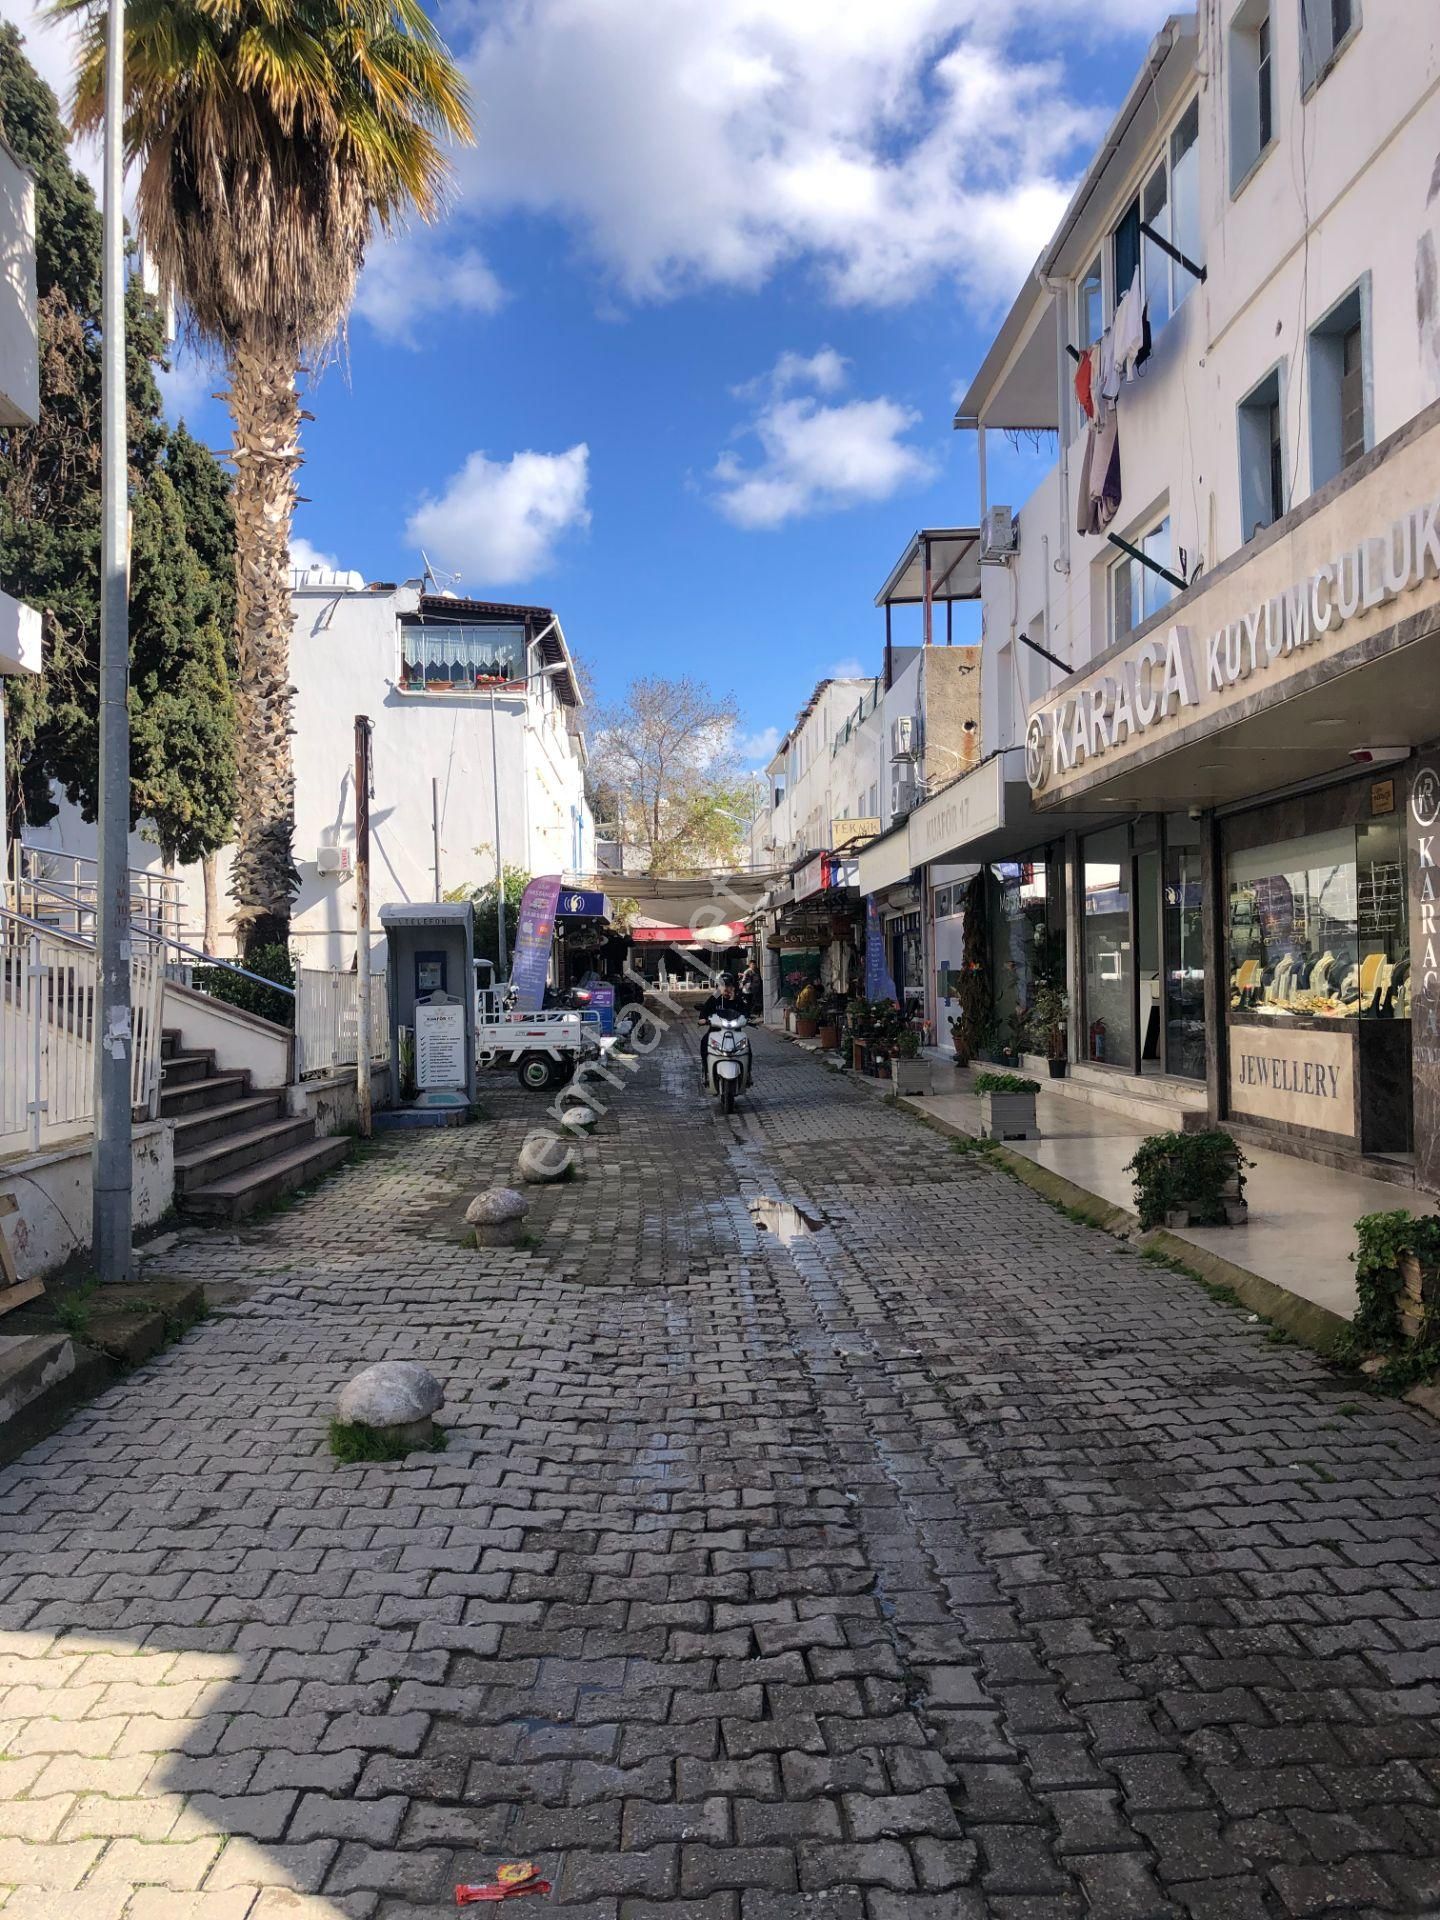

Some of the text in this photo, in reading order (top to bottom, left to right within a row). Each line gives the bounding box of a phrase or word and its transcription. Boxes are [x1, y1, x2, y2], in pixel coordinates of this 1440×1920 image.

[1054, 503, 1440, 775] KARACA KUYUMCULUK
[960, 797, 970, 830] 17
[403, 918, 447, 926] TELEFON
[1418, 835, 1438, 1035] KARACA
[1240, 1054, 1341, 1099] JEWELLERY
